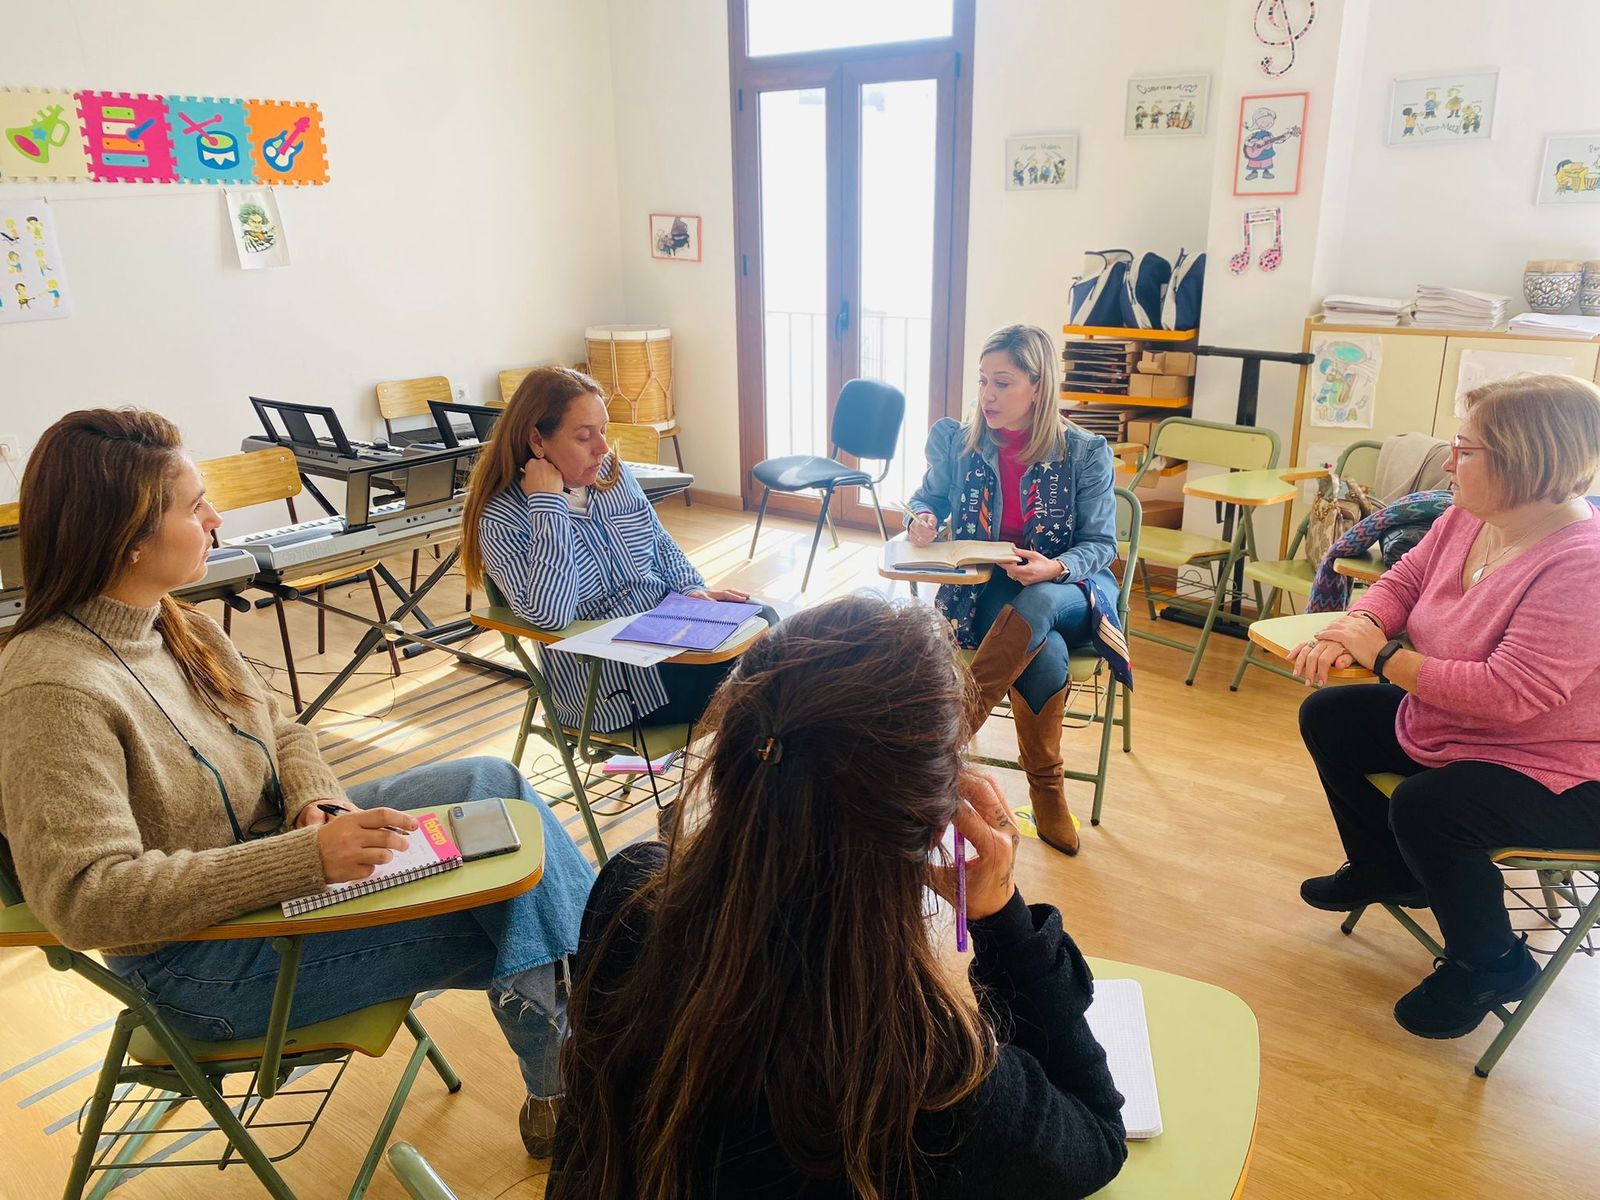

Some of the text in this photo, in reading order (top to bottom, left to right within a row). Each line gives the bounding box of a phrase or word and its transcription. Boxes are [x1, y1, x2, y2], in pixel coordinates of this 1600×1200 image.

[1315, 406, 1358, 423] TUBA
[1048, 473, 1059, 505] TOUS
[969, 488, 980, 512] FUN
[1045, 530, 1061, 544] FUN
